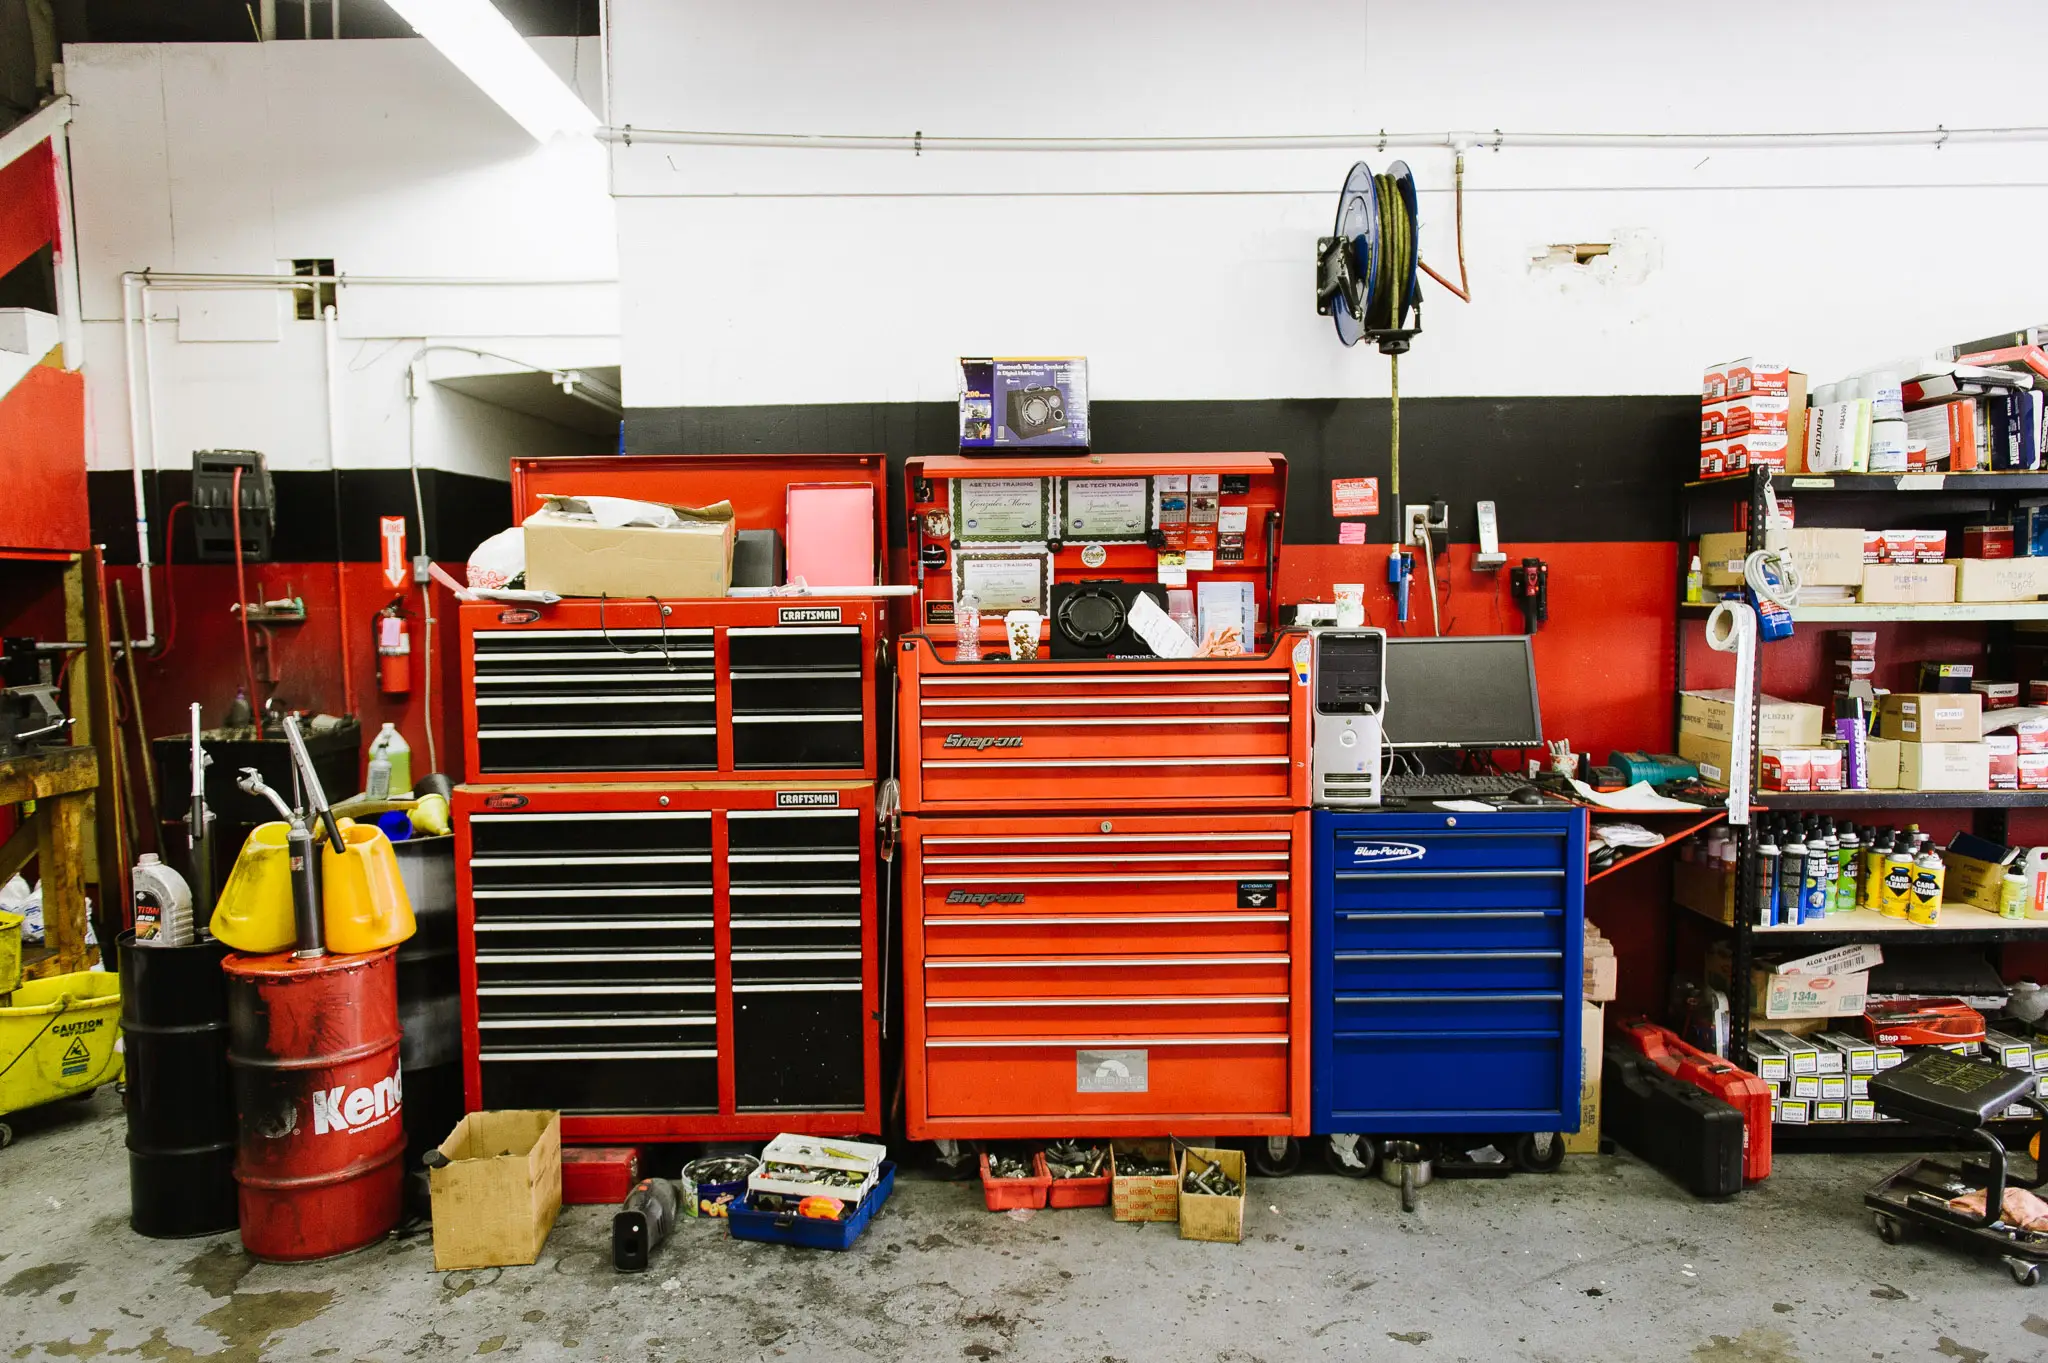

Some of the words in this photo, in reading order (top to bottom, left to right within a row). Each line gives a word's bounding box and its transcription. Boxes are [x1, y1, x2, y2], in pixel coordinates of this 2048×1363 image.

[965, 390, 979, 398] 200
[1814, 408, 1824, 458] PENTIUS
[782, 610, 838, 621] CRAFTSMAN
[943, 733, 1024, 750] Snap-on
[780, 794, 836, 804] CRAFTSMAN
[1890, 874, 1910, 883] CARB
[1916, 881, 1935, 889] CARB
[945, 890, 1025, 907] Snap-on
[1805, 956, 1823, 967] ALOE
[1824, 952, 1842, 961] VERA
[1842, 945, 1863, 956] DRINK
[1792, 991, 1817, 1001] 134a
[52, 1019, 103, 1033] CAUTION
[1879, 1034, 1899, 1042] Stop
